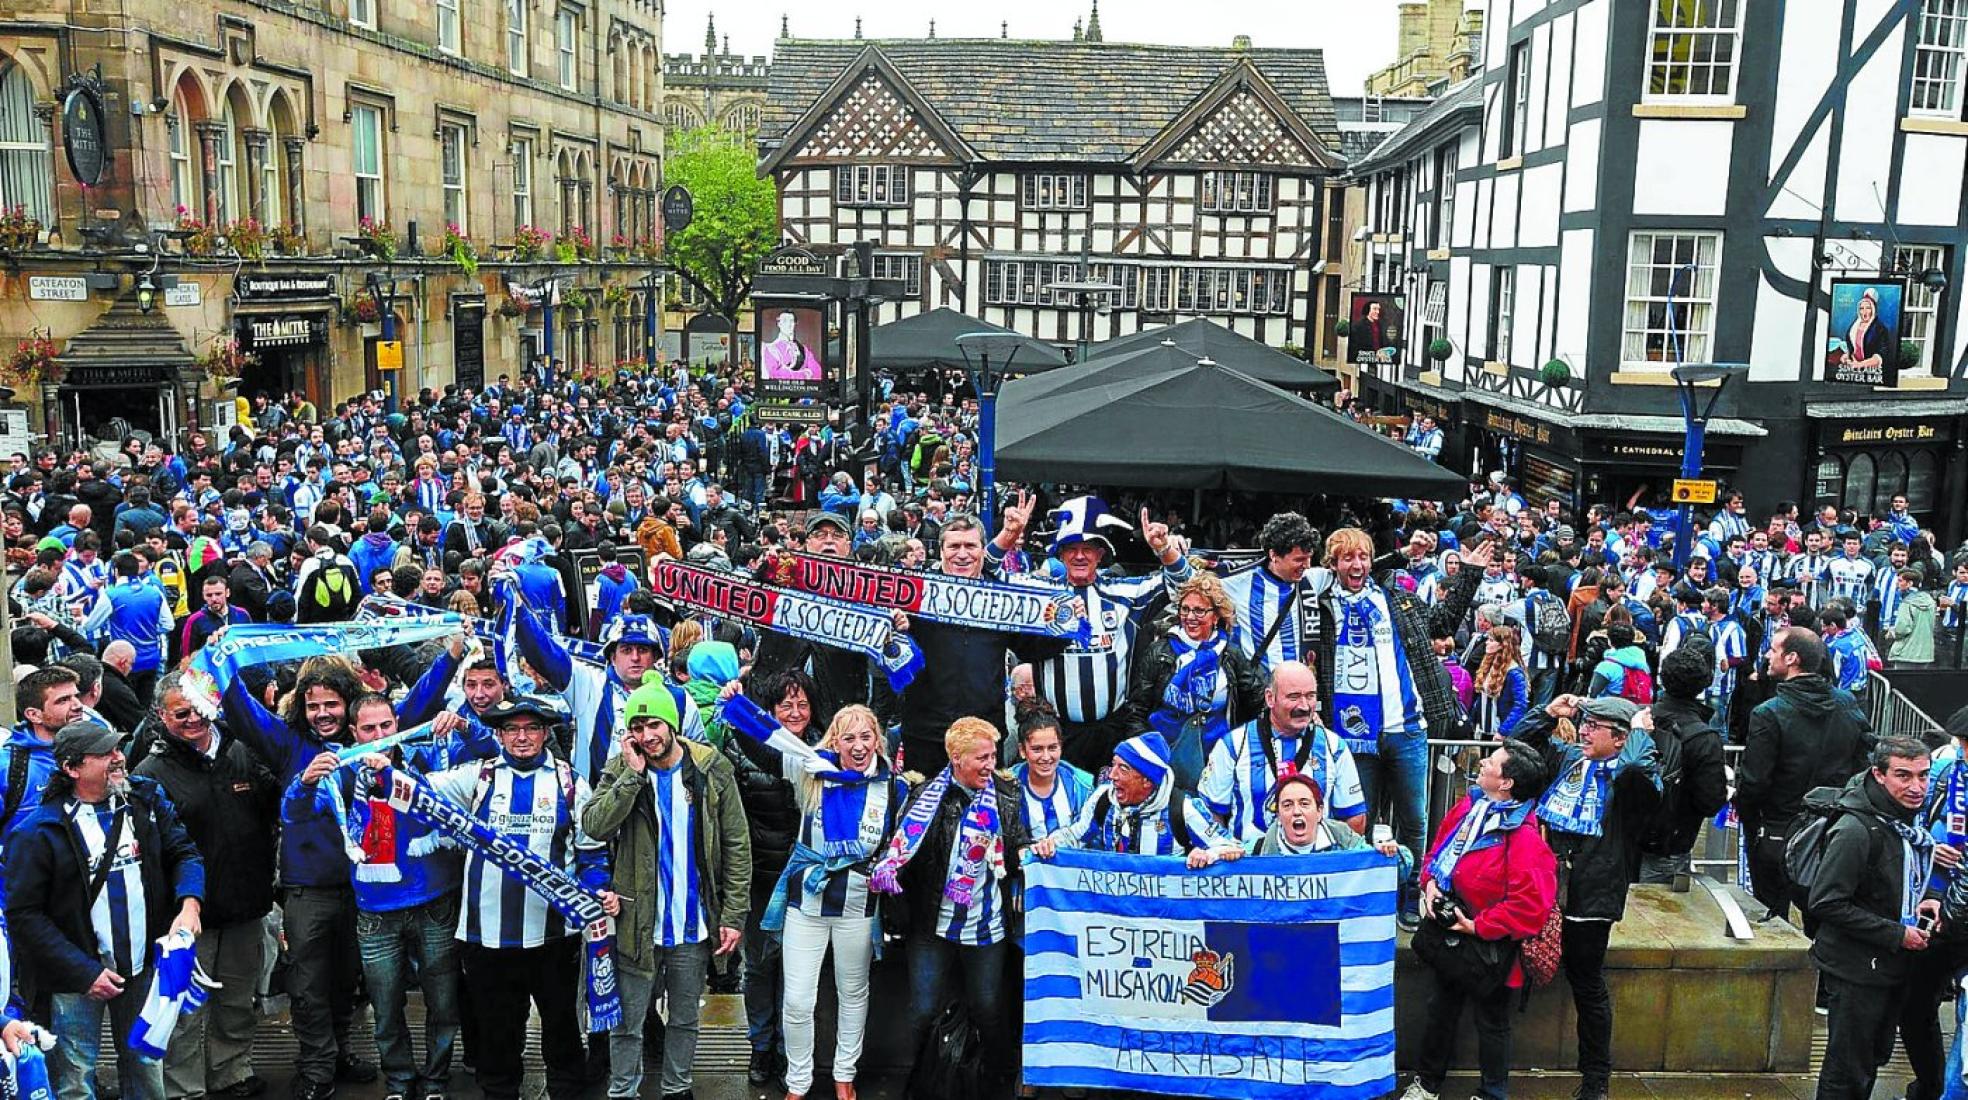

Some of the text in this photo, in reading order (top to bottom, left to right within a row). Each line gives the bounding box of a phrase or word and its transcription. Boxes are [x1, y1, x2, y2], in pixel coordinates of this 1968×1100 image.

[75, 127, 91, 139] THE
[73, 139, 97, 151] MITRE
[776, 255, 809, 265] GOOD
[764, 264, 822, 272] FOOD ALL DAY
[31, 278, 84, 289] CATEATON
[40, 288, 76, 298] STREET
[253, 320, 311, 337] THE MITRE
[1835, 372, 1883, 383] OYSTER BAR
[761, 410, 780, 418] REAL
[803, 410, 821, 418] ALES
[1885, 426, 1914, 441] Oyster
[1917, 425, 1935, 439] Bar
[1622, 446, 1674, 456] CATHEDRAL
[803, 558, 917, 606] UNITED
[658, 563, 768, 619] UNITED
[416, 791, 478, 841] REAL
[488, 837, 603, 920] SOCIEDAD
[1077, 870, 1328, 900] ARRASATE ERREALAREKIN
[1086, 926, 1207, 961] ESTRELLA
[1115, 1028, 1333, 1085] ARRASATE
